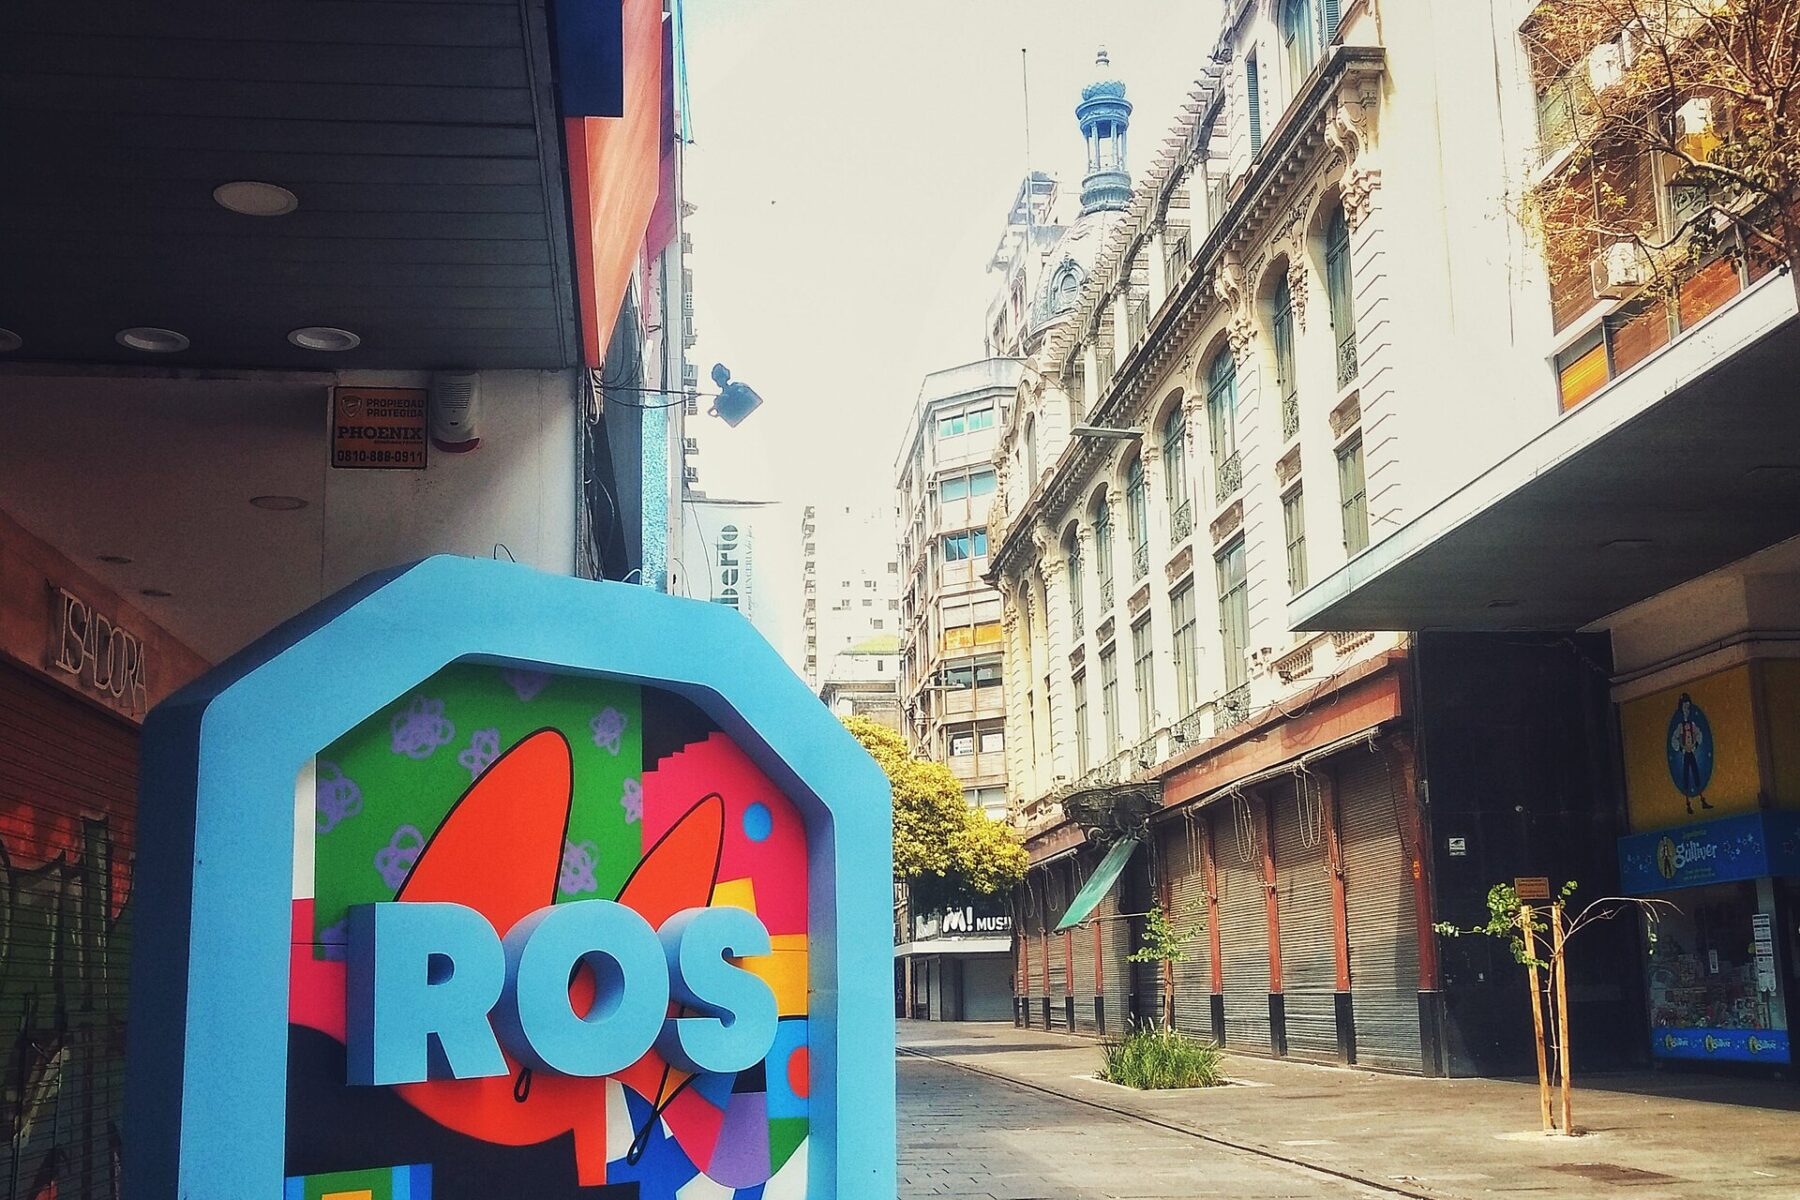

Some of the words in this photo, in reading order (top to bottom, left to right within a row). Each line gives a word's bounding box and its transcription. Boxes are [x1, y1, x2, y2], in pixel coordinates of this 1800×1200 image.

[366, 398, 424, 408] PROPIEDAD
[366, 408, 424, 418] PROTEGIDA
[337, 426, 423, 440] PHOENIX
[337, 450, 424, 463] 0810-888-0911
[713, 524, 739, 611] berto
[55, 587, 148, 714] ISADORA
[346, 899, 779, 1086] ROS
